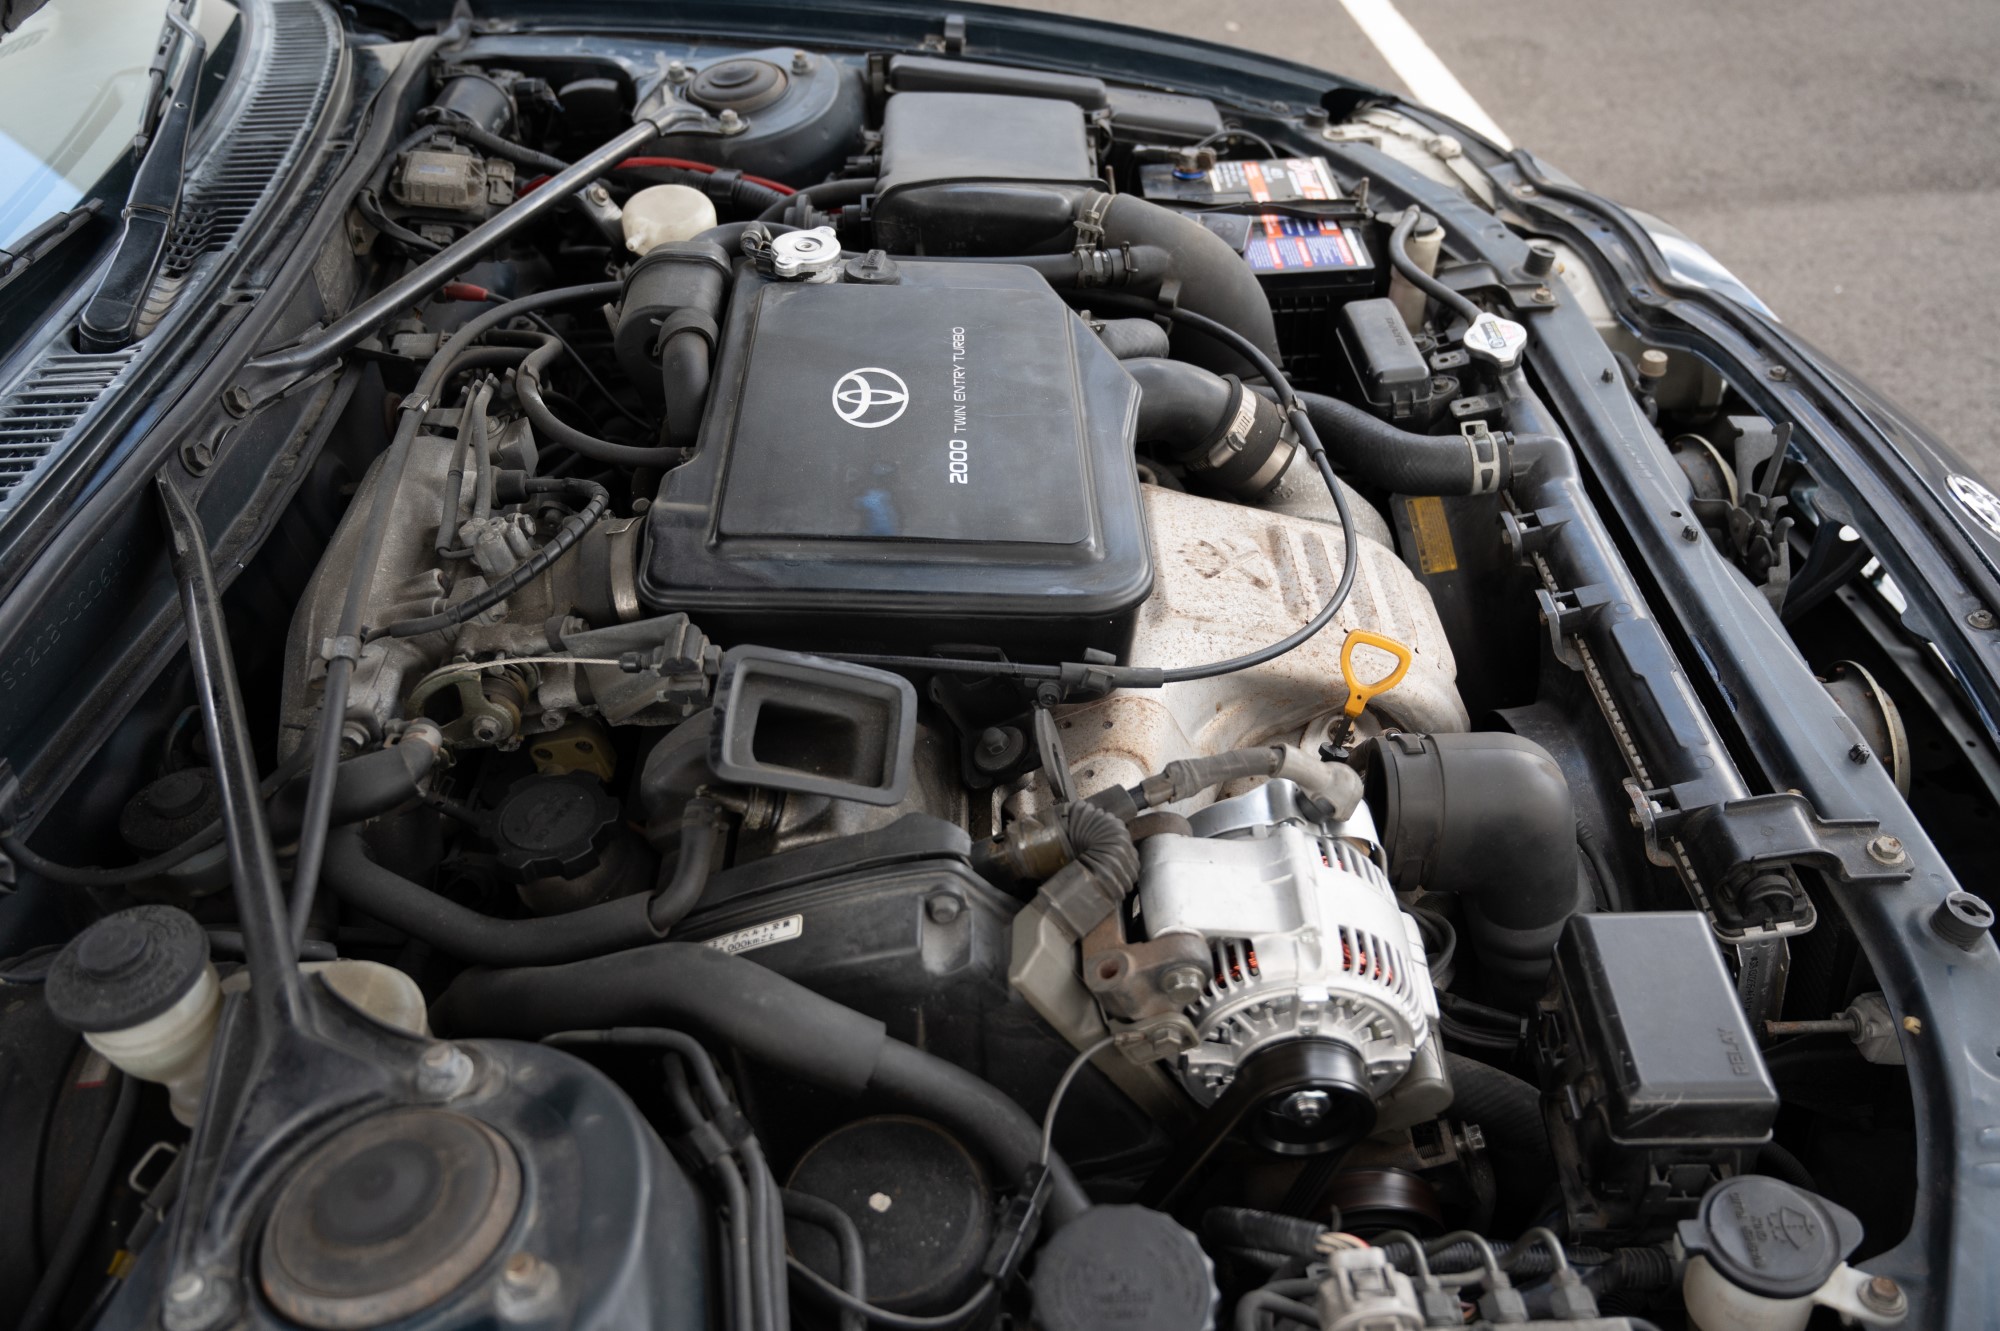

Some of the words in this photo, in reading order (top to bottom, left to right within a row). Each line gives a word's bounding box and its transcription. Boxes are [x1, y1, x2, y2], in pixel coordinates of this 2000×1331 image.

[953, 327, 965, 362] TURBO
[953, 365, 966, 401] ENTRY
[954, 405, 966, 433] TWIN
[949, 439, 968, 484] 2000
[1717, 1027, 1750, 1077] RELAY
